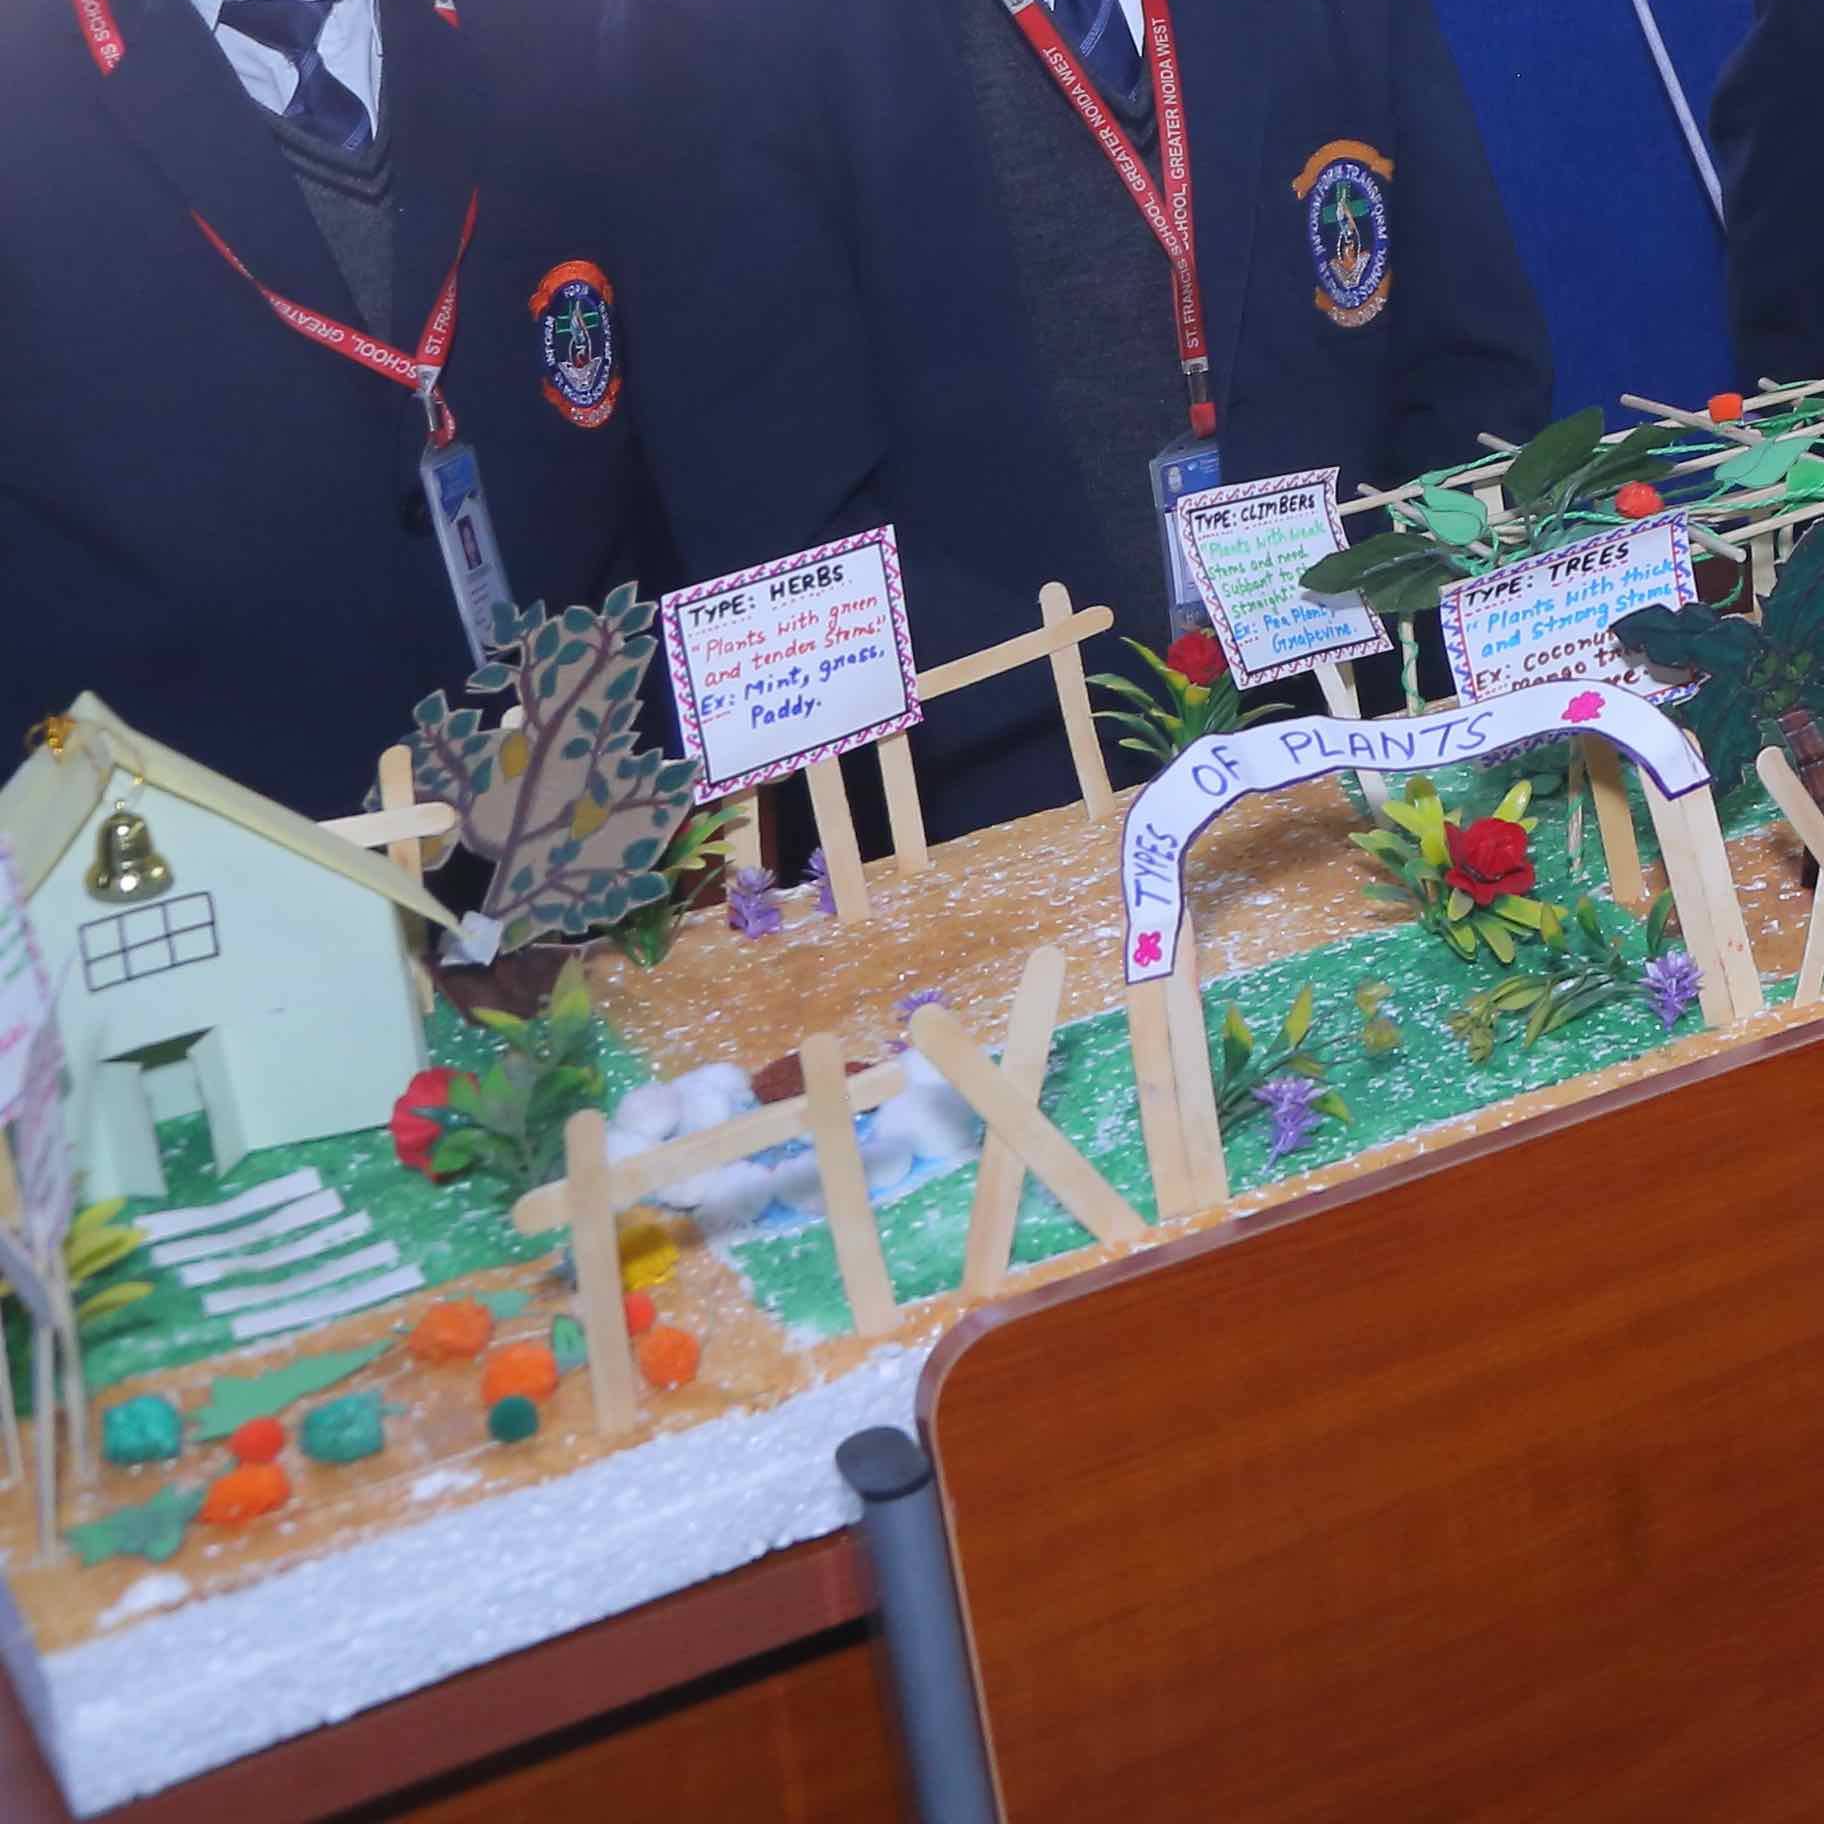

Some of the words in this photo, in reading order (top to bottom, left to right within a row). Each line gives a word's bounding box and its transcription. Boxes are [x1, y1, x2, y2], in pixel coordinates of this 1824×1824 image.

[1151, 17, 1170, 56] WEST
[1041, 46, 1076, 88] WEST
[1158, 58, 1176, 104] NOIDA
[1072, 84, 1107, 129] NOIDA
[1100, 127, 1147, 194] GREATER
[1165, 108, 1186, 179] GREATER
[424, 335, 445, 356] ST.
[1194, 510, 1238, 535] TYPE:
[1240, 493, 1316, 524] CLIMBERS
[689, 594, 756, 628] TYPE:
[769, 564, 845, 602] HERBS
[1465, 575, 1534, 608] TYPE:
[1549, 541, 1630, 582] TREES
[1565, 580, 1614, 610] with
[1622, 558, 1675, 587] thick
[777, 612, 820, 638] with
[829, 596, 879, 628] green
[704, 663, 742, 688] and
[752, 640, 817, 671] tender
[1481, 631, 1521, 658] and
[700, 694, 735, 718] Ex:
[744, 665, 810, 701] Mint,
[818, 644, 885, 683] grass,
[1476, 664, 1511, 691] Ex:
[750, 694, 823, 729] Paddy.
[1133, 823, 1180, 908] TYPES
[1191, 746, 1240, 798] OF
[1280, 712, 1494, 765] PLANTS
